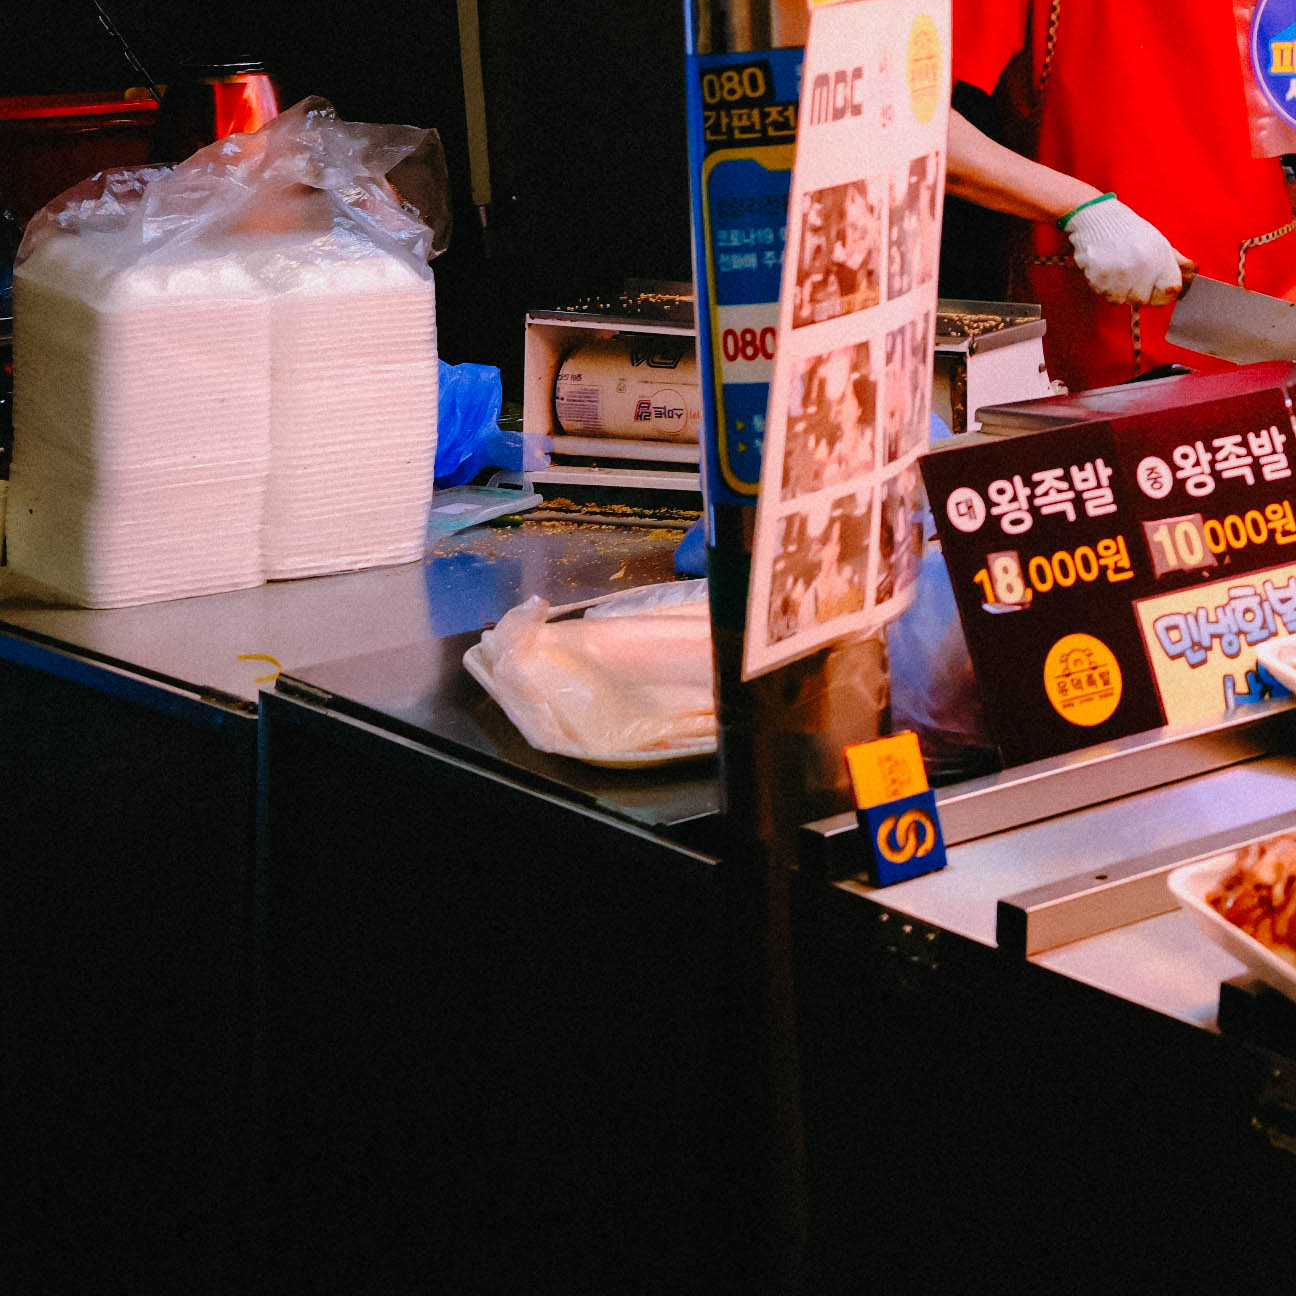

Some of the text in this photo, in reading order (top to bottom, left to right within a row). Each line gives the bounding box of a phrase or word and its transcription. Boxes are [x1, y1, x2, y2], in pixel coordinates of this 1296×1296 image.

[702, 66, 766, 104] 080
[986, 458, 1119, 536] 왕족발
[1172, 425, 1293, 498] 왕족발
[972, 535, 1135, 605] 18,000원
